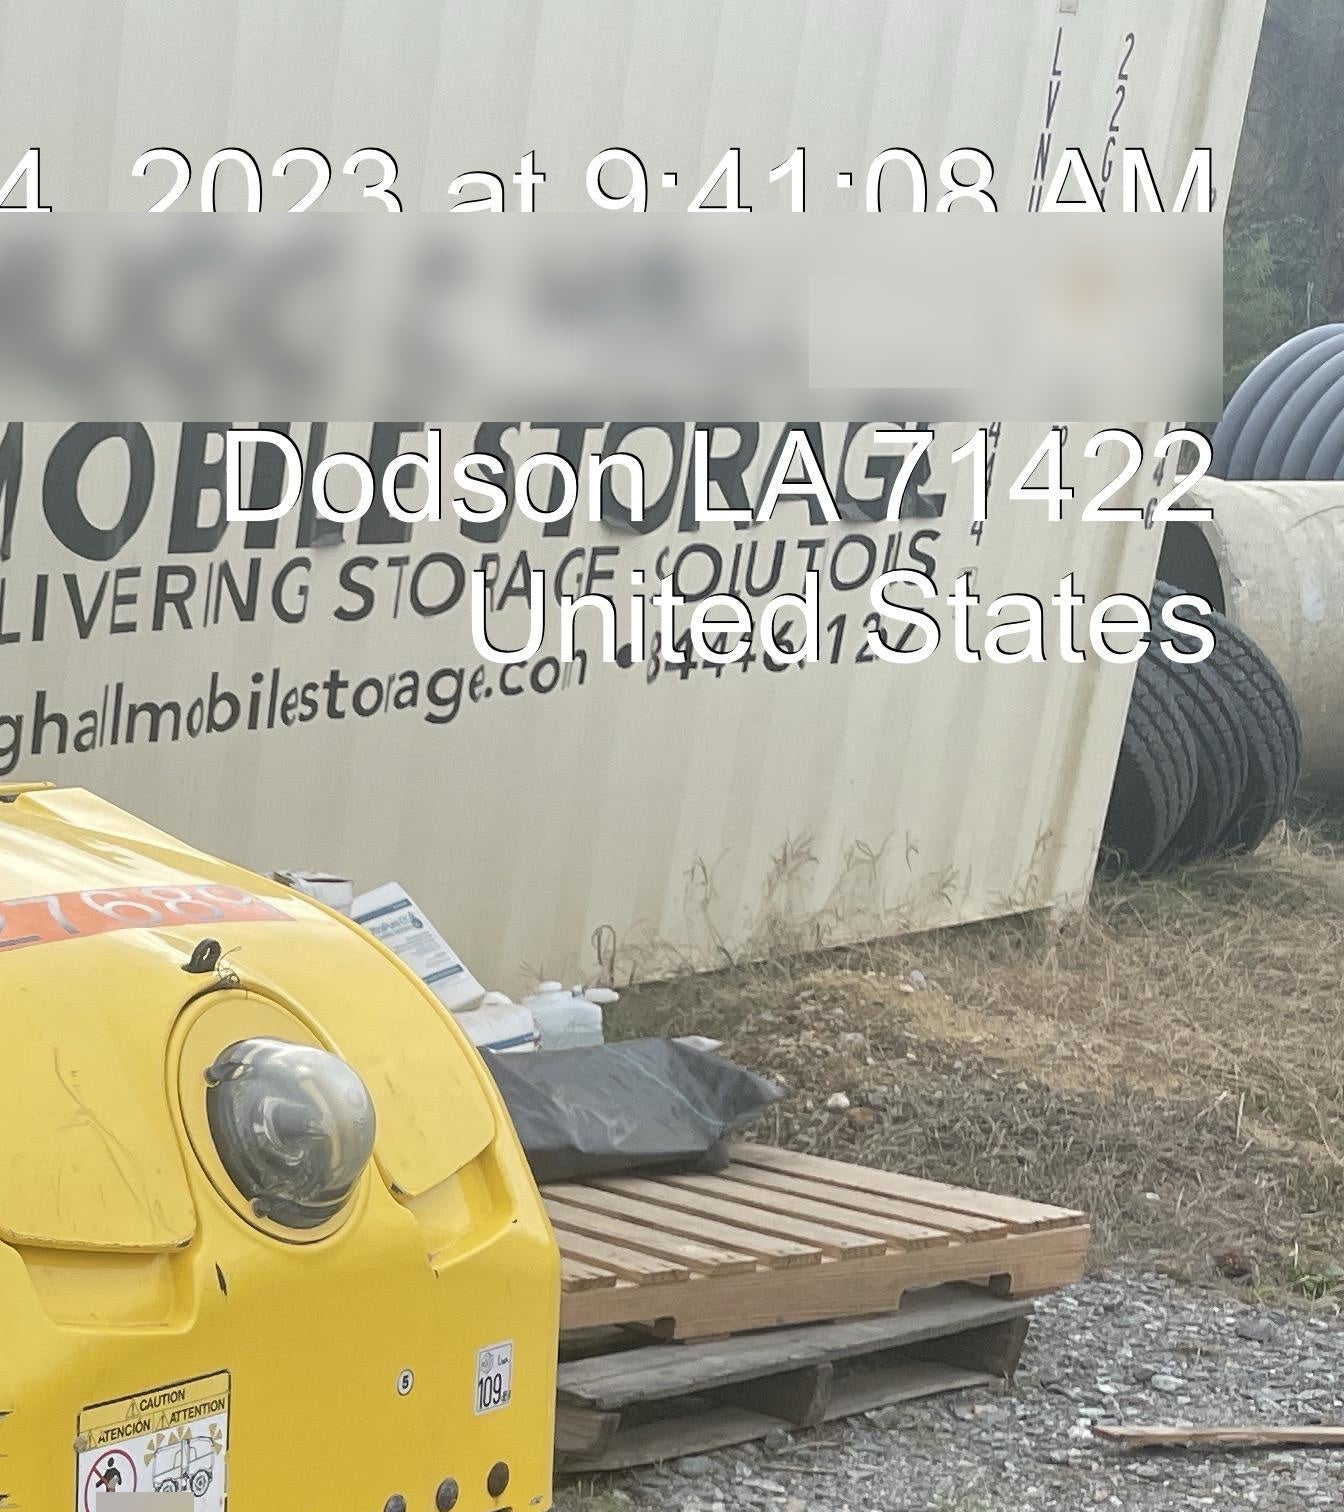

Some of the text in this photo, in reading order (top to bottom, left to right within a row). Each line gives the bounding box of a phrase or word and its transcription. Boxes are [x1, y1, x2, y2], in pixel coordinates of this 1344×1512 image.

[460, 422, 947, 543] STORAGE
[333, 545, 620, 622] STORAGE
[138, 1388, 186, 1412] CAUTION
[401, 1374, 410, 1390] 5
[477, 1373, 503, 1410] 109
[97, 1397, 226, 1444] ATENCIÓN ATTENTION
